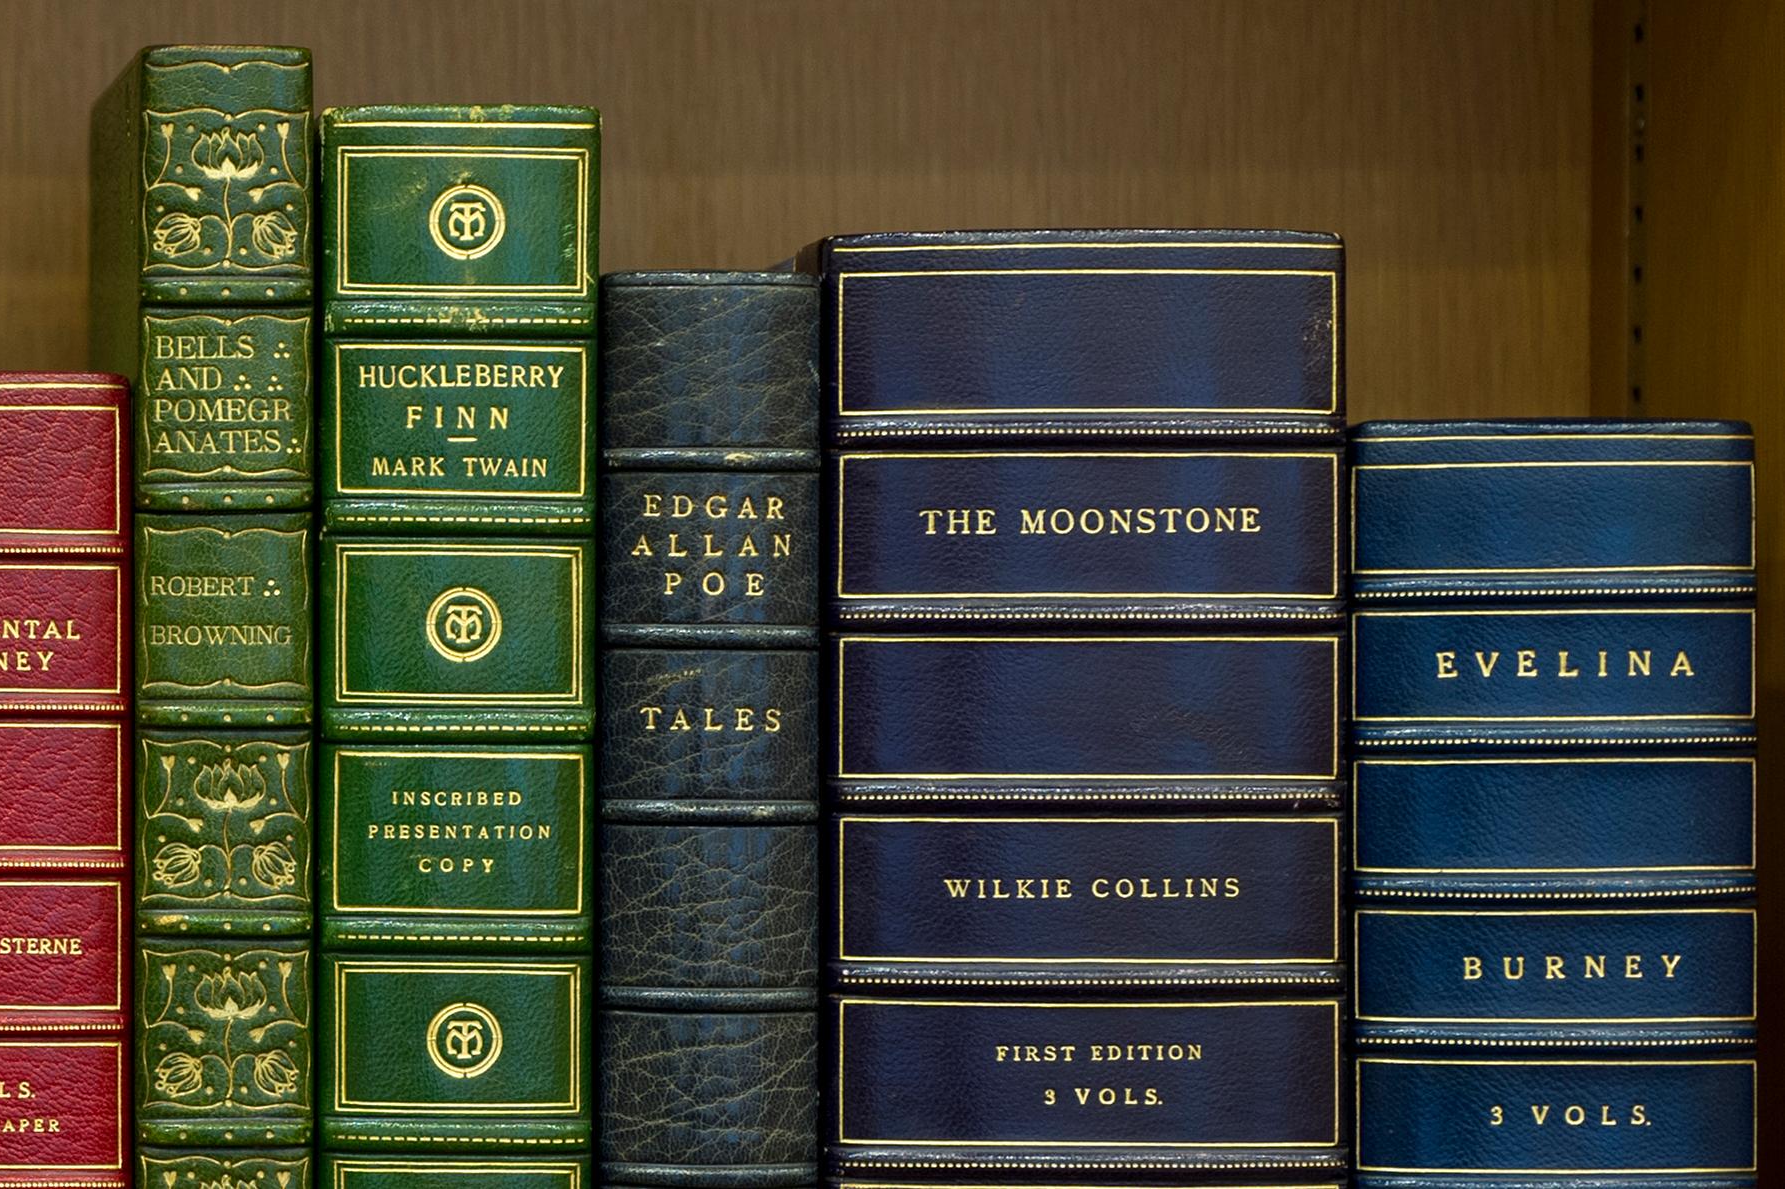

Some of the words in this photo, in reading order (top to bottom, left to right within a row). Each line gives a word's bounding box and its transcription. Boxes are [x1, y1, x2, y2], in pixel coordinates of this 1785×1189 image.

[156, 335, 255, 360] BELLS
[156, 366, 222, 391] AND
[359, 363, 564, 389] HUCKLEBERRY
[155, 398, 290, 423] POMEGR
[406, 406, 508, 430] FINN
[152, 429, 282, 455] ANATES
[371, 456, 445, 477] MARK
[462, 457, 547, 478] TWAIN
[643, 494, 784, 520] EDGAR
[919, 509, 997, 535] THE
[1020, 507, 1261, 535] MOONSTONE
[631, 533, 791, 558] ALLAN
[151, 575, 255, 597] ROBERT
[664, 572, 764, 596] POE
[151, 625, 291, 646] BROWNING
[1436, 650, 1695, 679] EVELINA
[640, 707, 781, 732] TALES
[392, 791, 522, 807] INSCRIBED
[368, 824, 550, 840] PRESENTATION
[418, 857, 494, 873] COPY
[943, 879, 1072, 899] WILKIE
[1091, 877, 1240, 899] COLLINS
[0, 937, 83, 955] STERNE
[1463, 954, 1681, 980] BURNEY
[996, 1045, 1075, 1062] FIRST
[1091, 1044, 1201, 1061] EDITION
[1044, 1089, 1056, 1105] 3
[1074, 1088, 1163, 1105] VOLS.
[1490, 1105, 1503, 1126] 3
[1531, 1105, 1651, 1126] VOLS.
